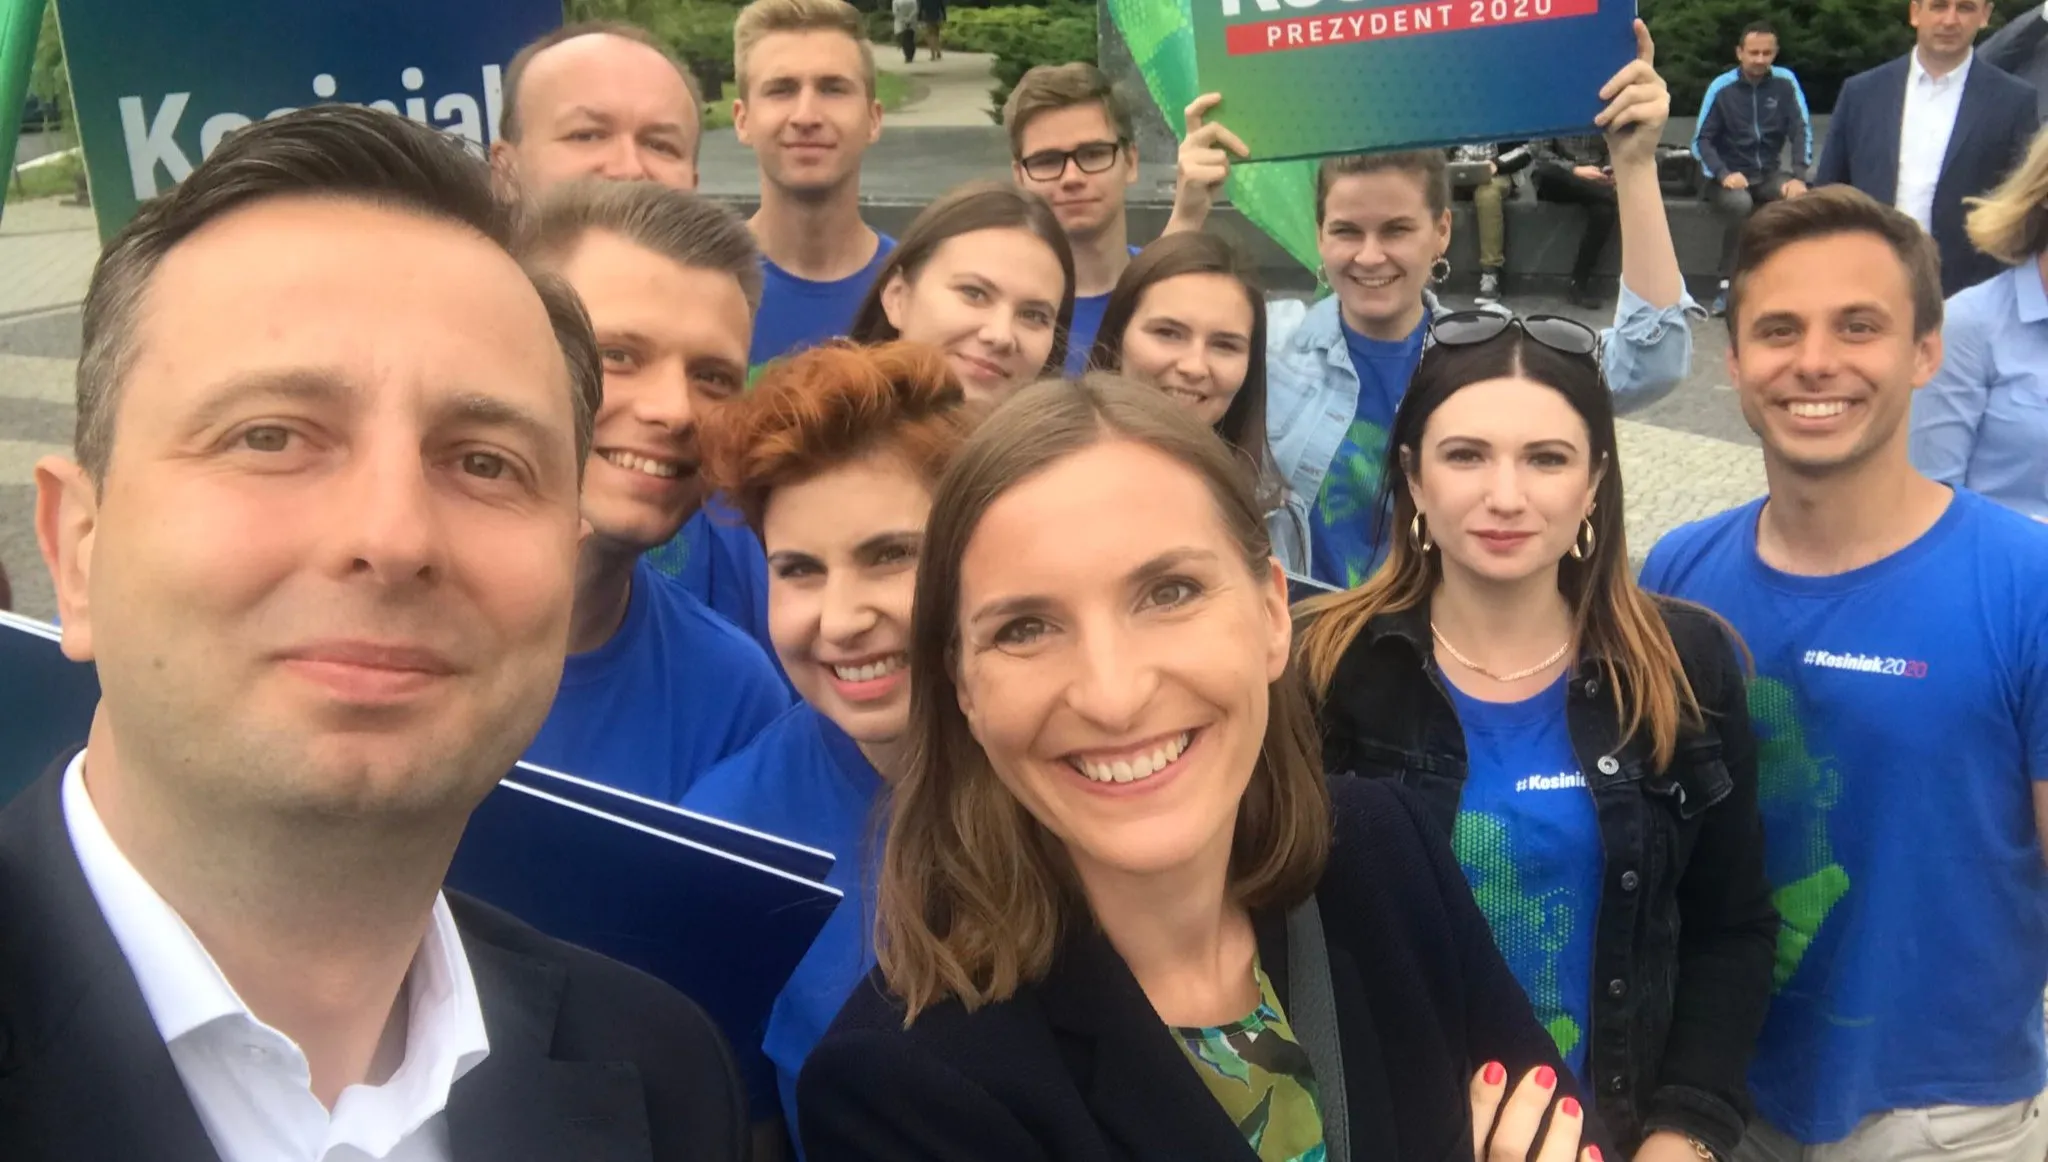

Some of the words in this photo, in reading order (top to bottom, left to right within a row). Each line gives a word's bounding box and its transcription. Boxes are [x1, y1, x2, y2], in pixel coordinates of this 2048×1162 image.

[1267, 4, 1453, 47] PREZYDENT
[1470, 0, 1551, 23] 2020
[1804, 650, 1928, 678] #Kosiniak2020
